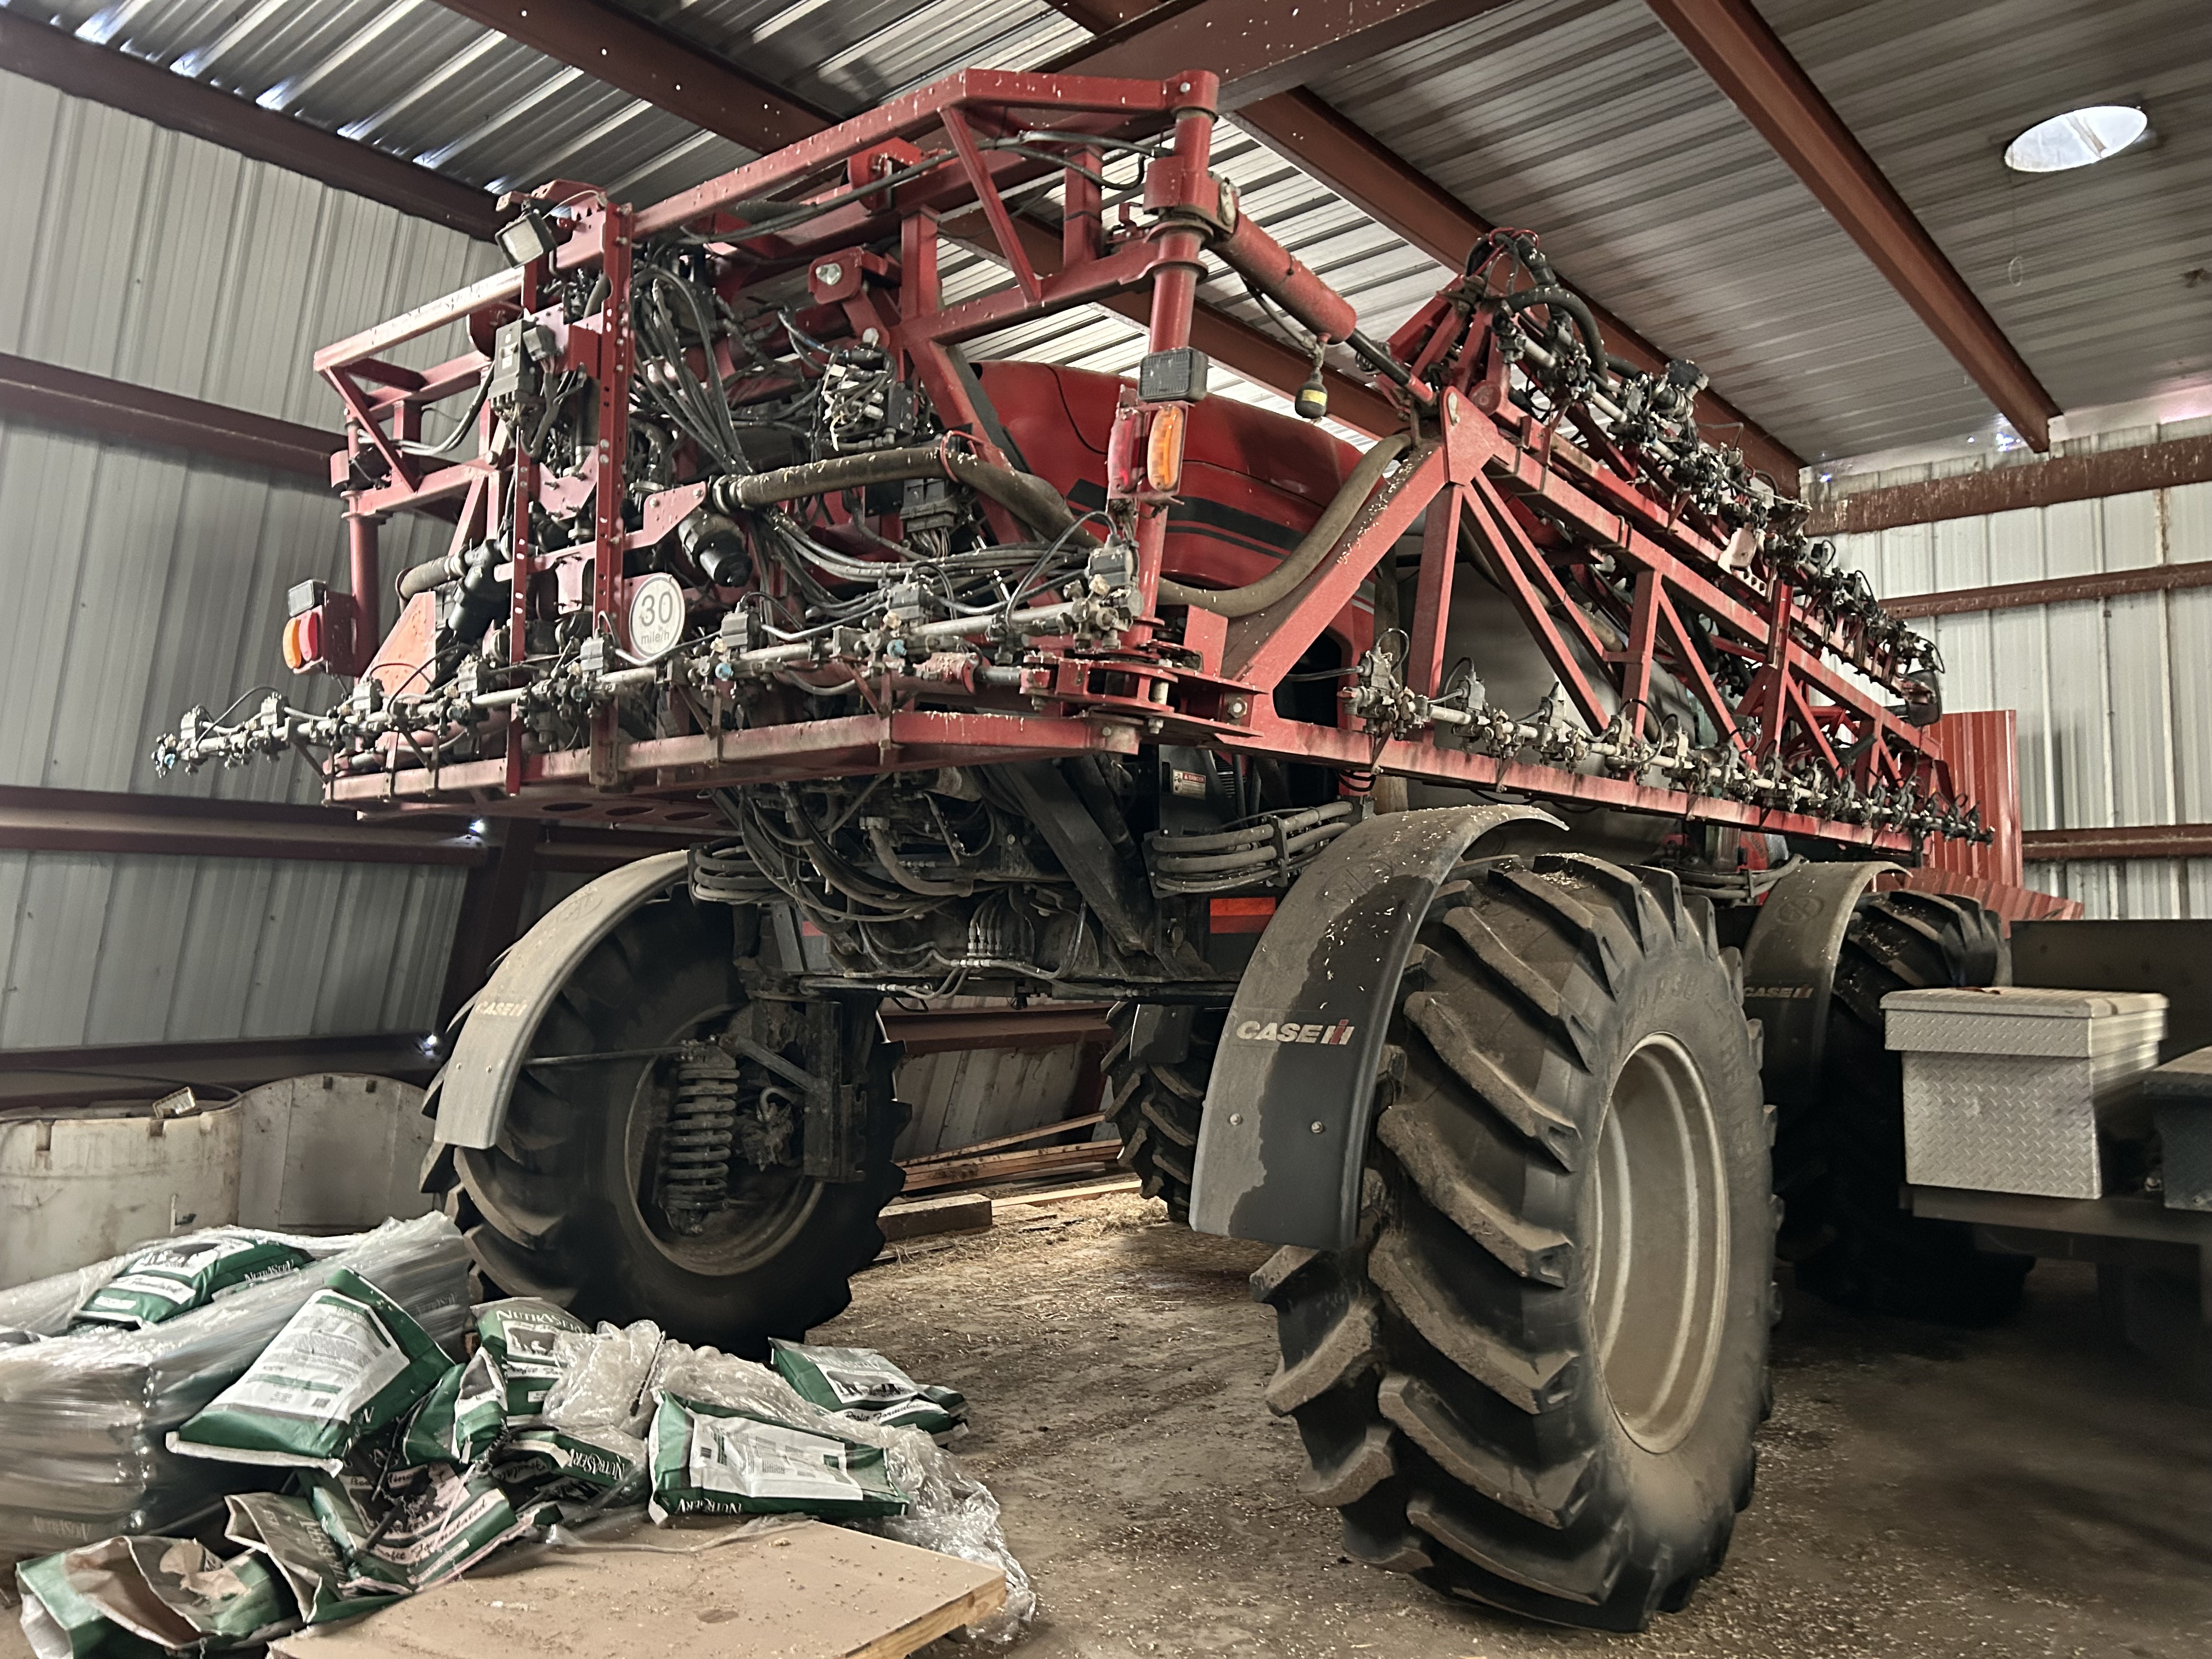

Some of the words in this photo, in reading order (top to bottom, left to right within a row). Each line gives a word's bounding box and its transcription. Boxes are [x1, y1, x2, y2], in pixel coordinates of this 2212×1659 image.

[641, 591, 673, 627] 30
[641, 630, 669, 645] mile/h
[1188, 774, 1204, 782] DANGER
[1745, 987, 1794, 998] CASE
[476, 1001, 515, 1016] CASE
[1237, 1020, 1323, 1043] CASE
